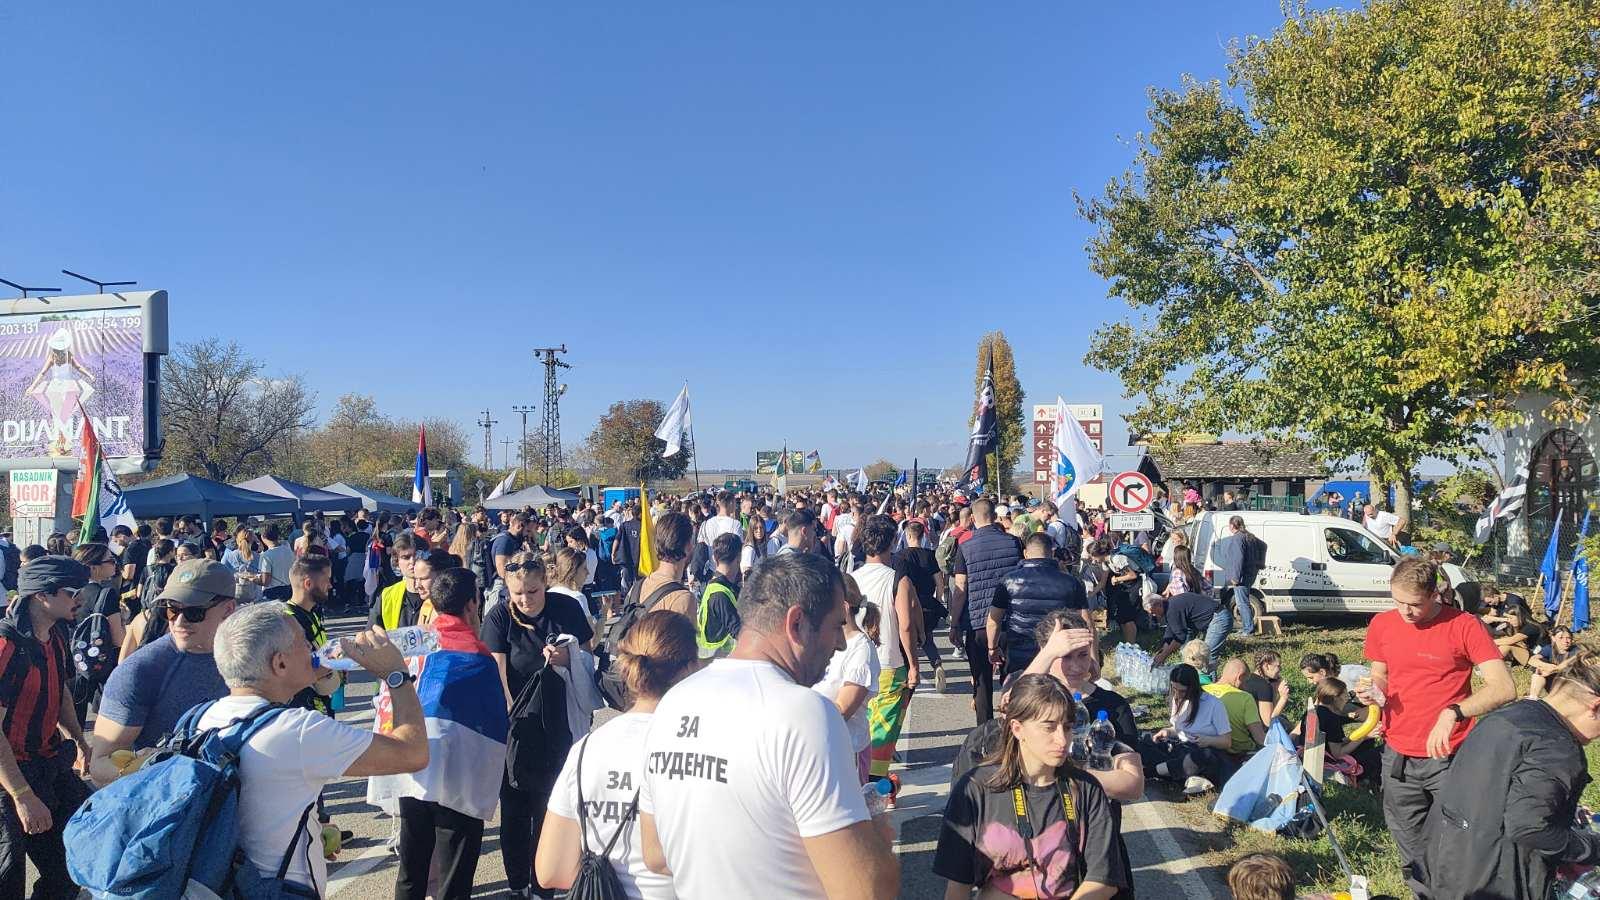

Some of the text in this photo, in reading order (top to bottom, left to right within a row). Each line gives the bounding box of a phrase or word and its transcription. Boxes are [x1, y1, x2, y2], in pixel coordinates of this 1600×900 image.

[121, 316, 141, 328] 199
[13, 472, 52, 482] RASADNIK
[17, 484, 49, 502] IGOR
[676, 715, 700, 738] ЗА
[648, 751, 728, 784] СТУДЕНТЕ
[606, 770, 633, 791] ЗА
